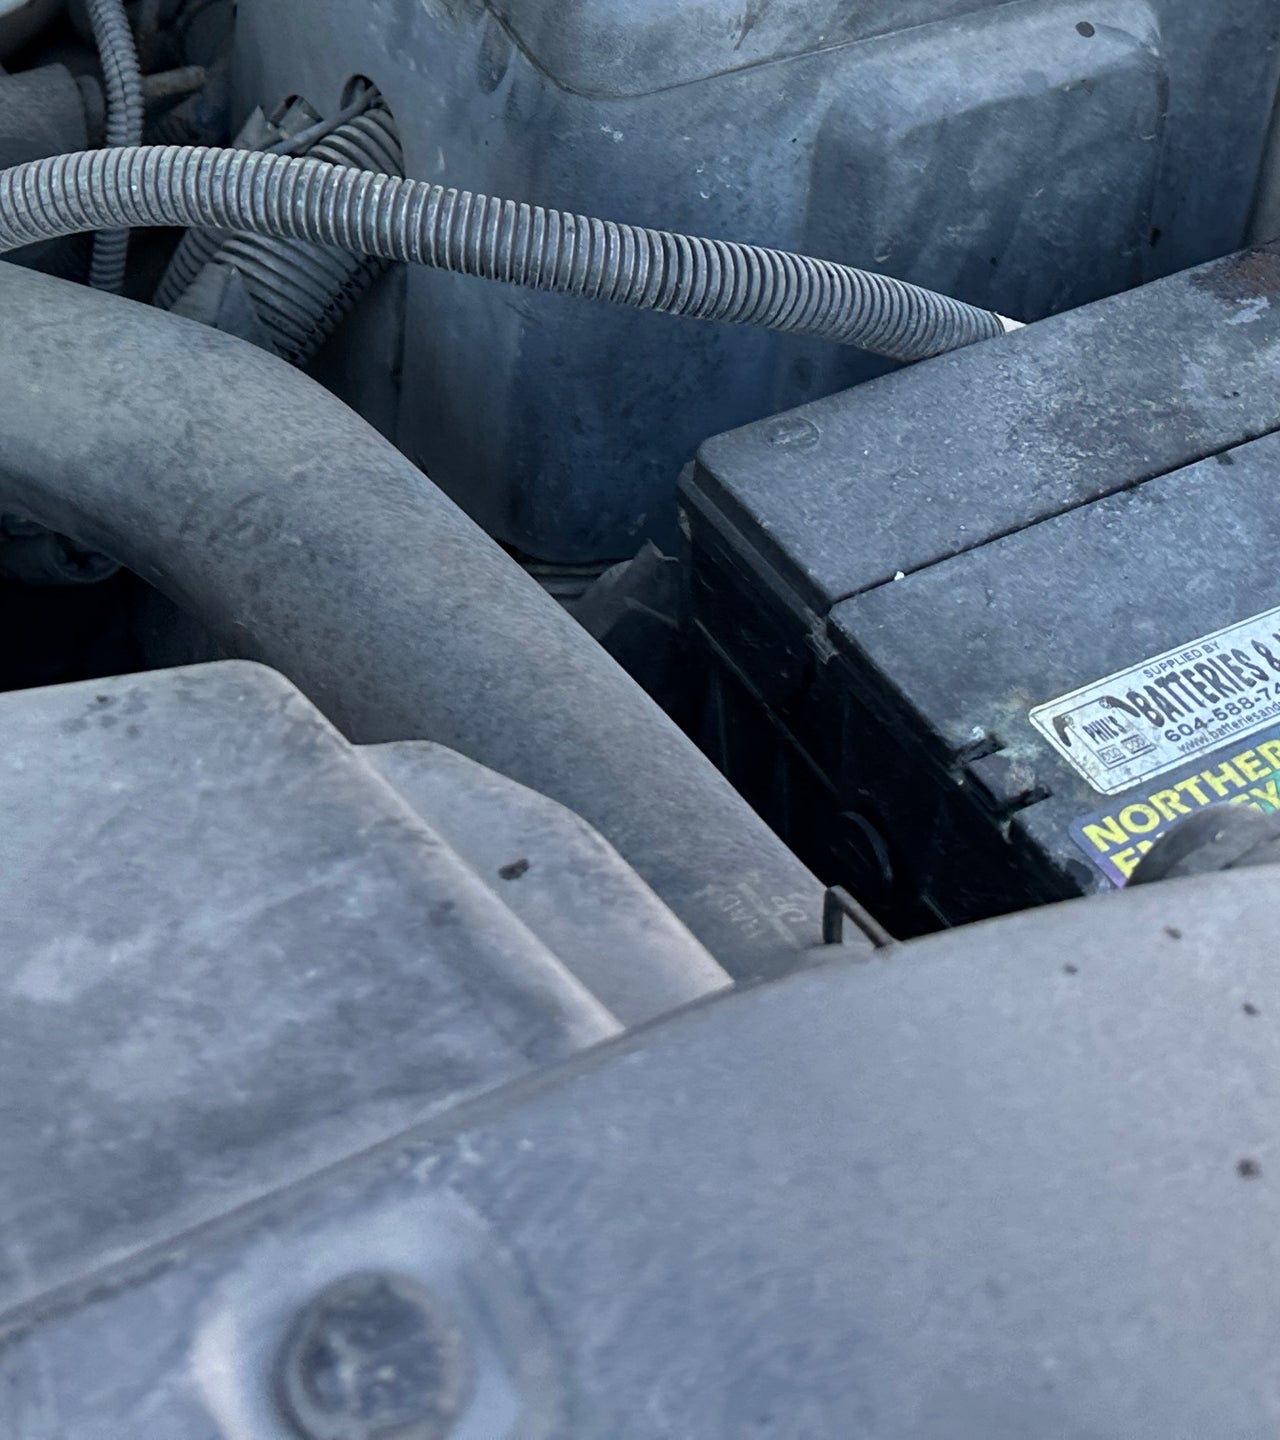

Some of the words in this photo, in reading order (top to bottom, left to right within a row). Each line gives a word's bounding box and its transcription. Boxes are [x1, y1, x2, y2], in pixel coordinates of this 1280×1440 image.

[1143, 649, 1203, 678] SUPPLIED
[1201, 641, 1220, 655] BY
[1126, 649, 1269, 727] BATTERIES
[1082, 716, 1127, 745] PHIL'S
